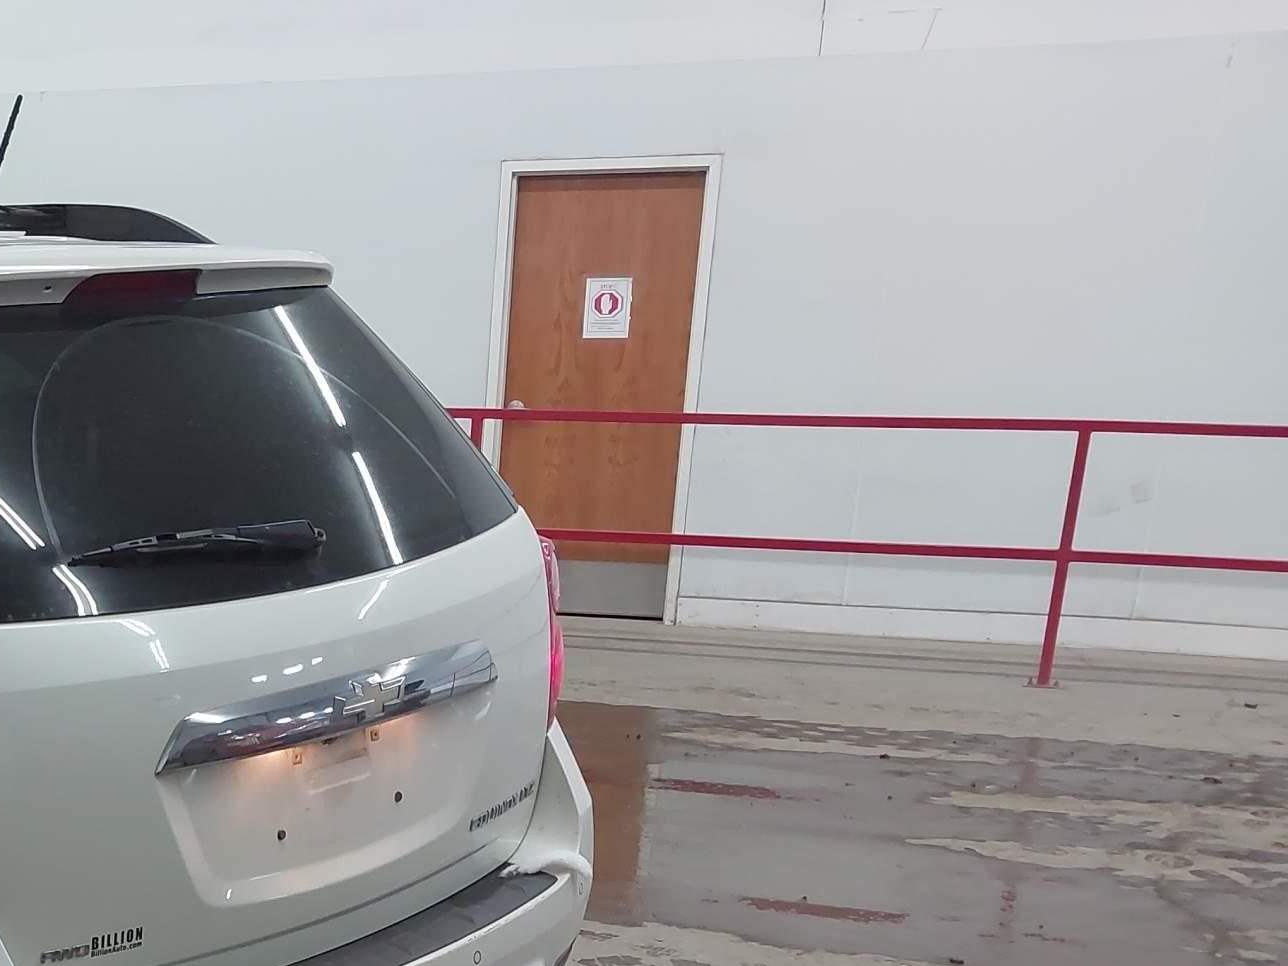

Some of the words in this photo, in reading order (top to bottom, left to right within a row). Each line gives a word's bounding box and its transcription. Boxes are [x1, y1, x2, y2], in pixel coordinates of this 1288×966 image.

[91, 927, 143, 950] BILLION
[40, 945, 90, 964] AWD
[91, 941, 142, 957] BillionAuto.com
